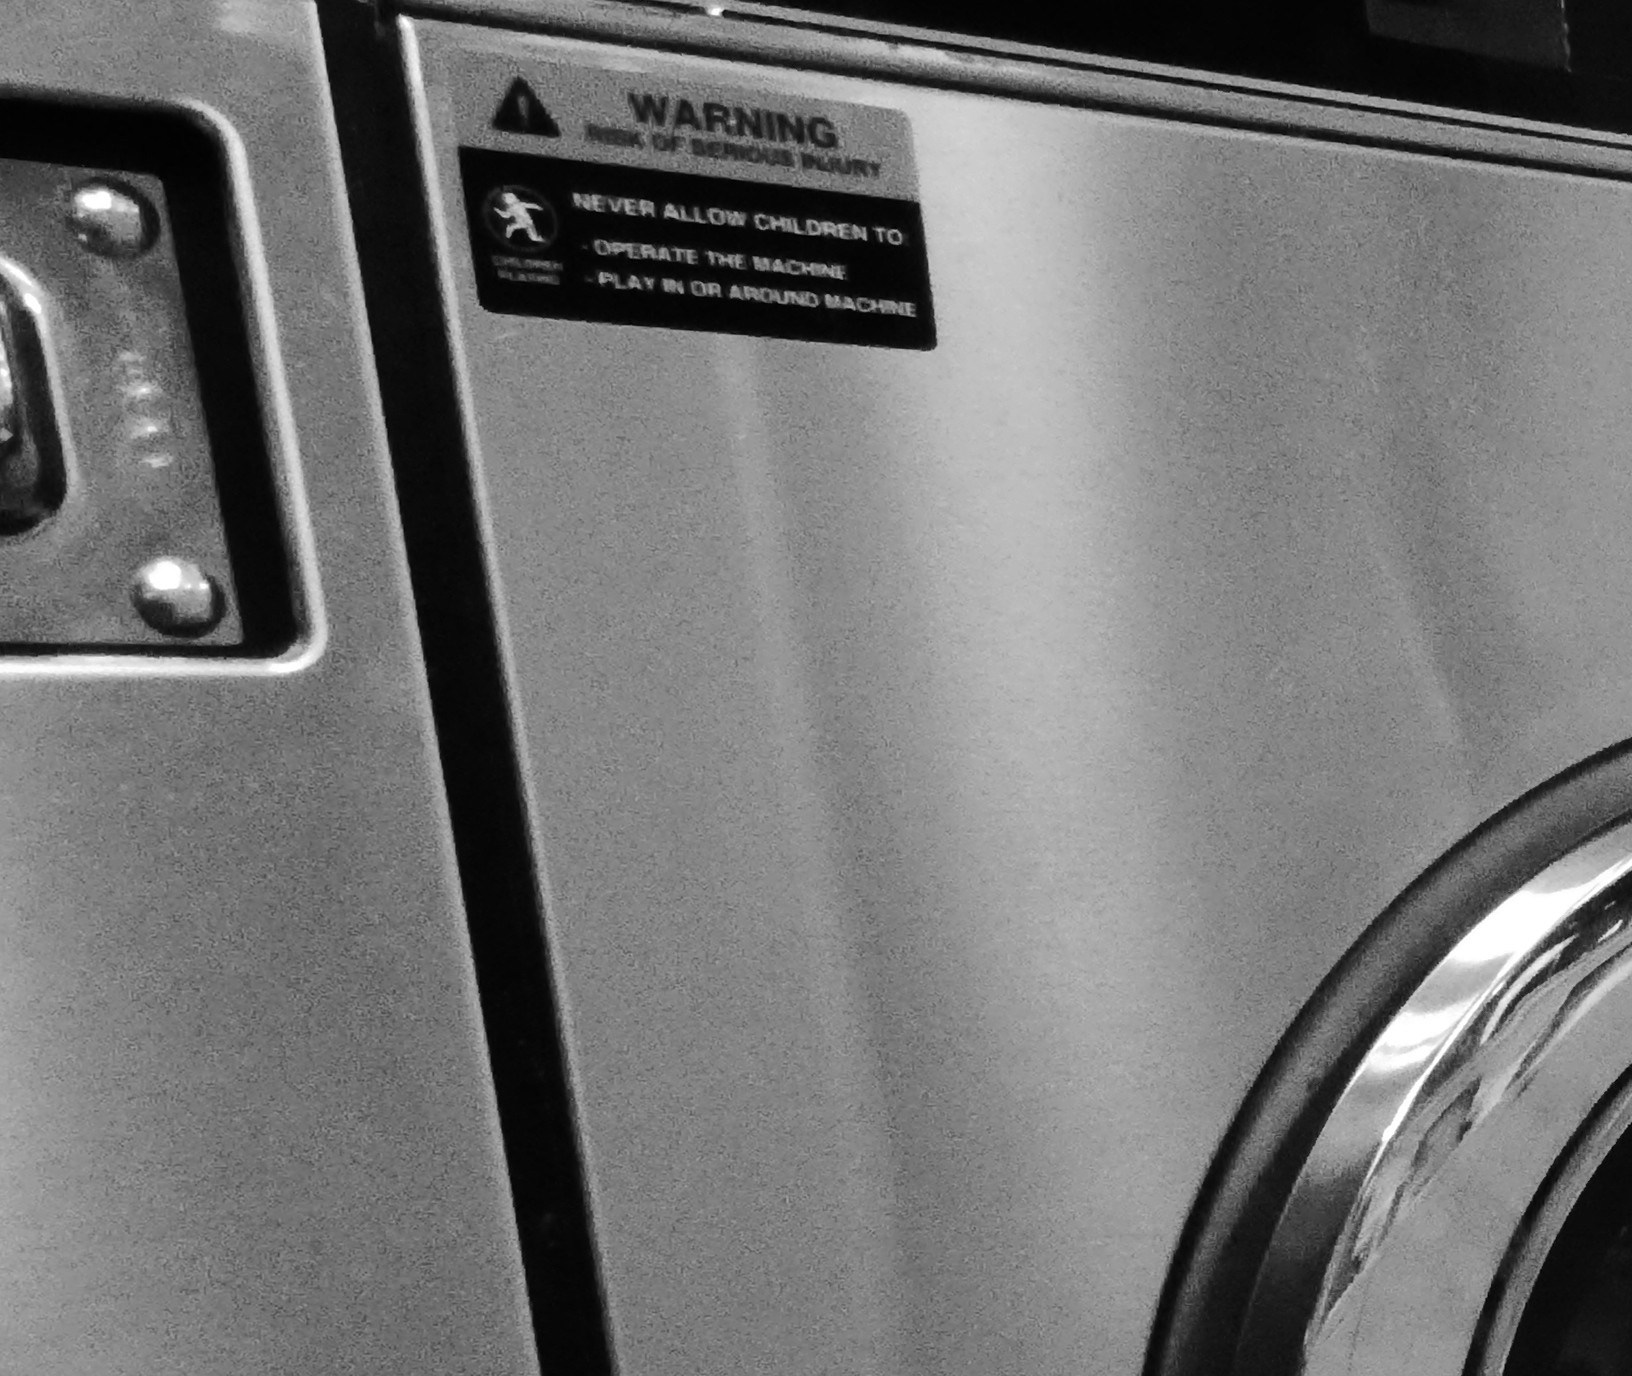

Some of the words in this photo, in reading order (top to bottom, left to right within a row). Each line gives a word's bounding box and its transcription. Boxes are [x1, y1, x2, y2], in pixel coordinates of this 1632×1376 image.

[626, 92, 839, 148] WARNING
[572, 192, 656, 217] NEVER
[664, 203, 747, 227] ALLOW
[753, 213, 868, 242] CHILDREN
[872, 227, 904, 246] TO
[593, 239, 699, 265] OPERATE
[705, 250, 748, 270] THE
[752, 256, 848, 280] MACHINE
[598, 271, 655, 291] PLAY
[661, 278, 685, 295] IN
[690, 280, 723, 299] OR
[728, 285, 820, 308] AROUND
[824, 294, 918, 318] MACHINE
